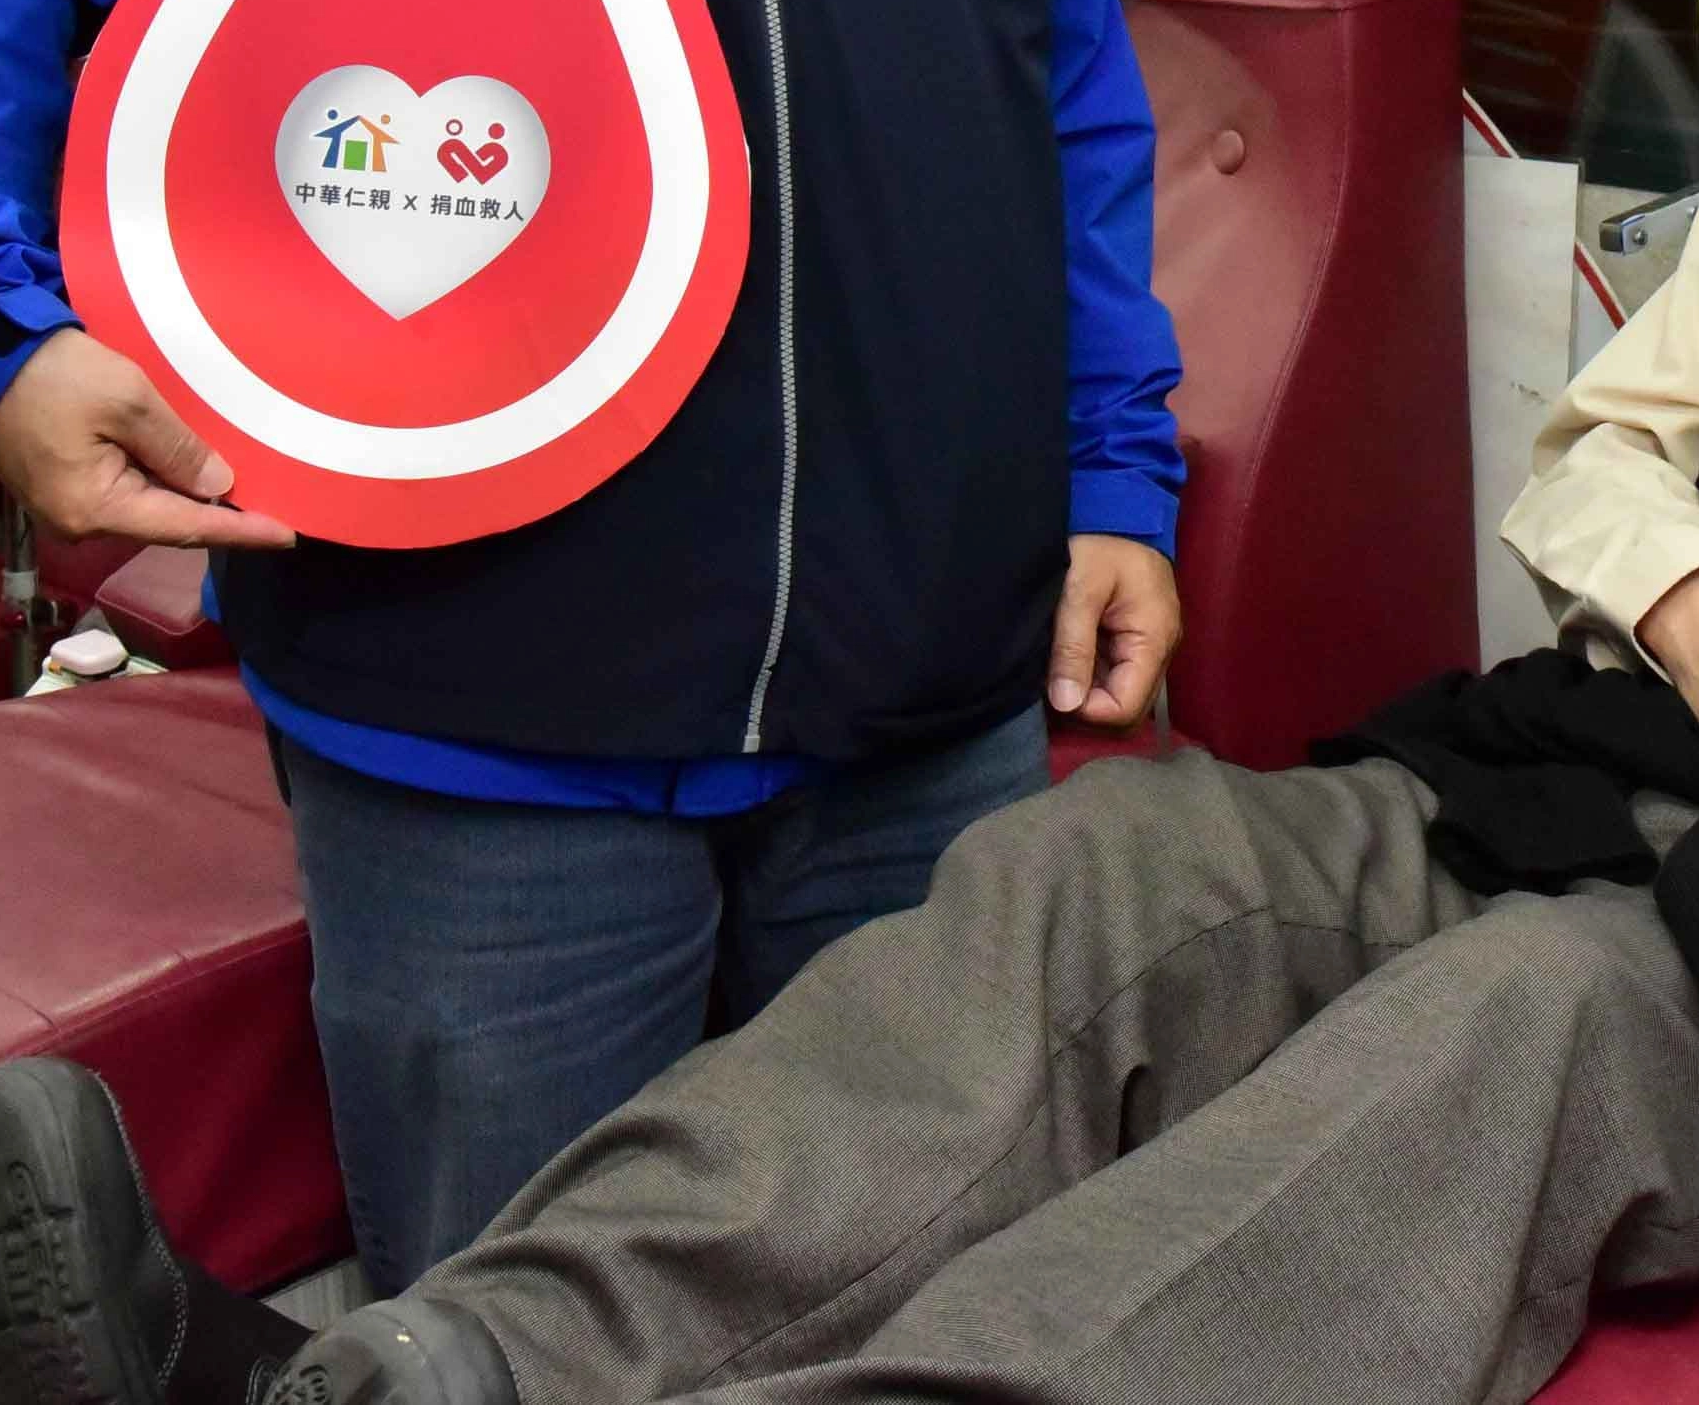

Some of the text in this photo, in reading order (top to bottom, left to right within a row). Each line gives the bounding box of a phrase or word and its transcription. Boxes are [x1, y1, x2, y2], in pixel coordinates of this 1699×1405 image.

[294, 182, 392, 211] 中華仁親
[430, 194, 525, 222] 捐血救人
